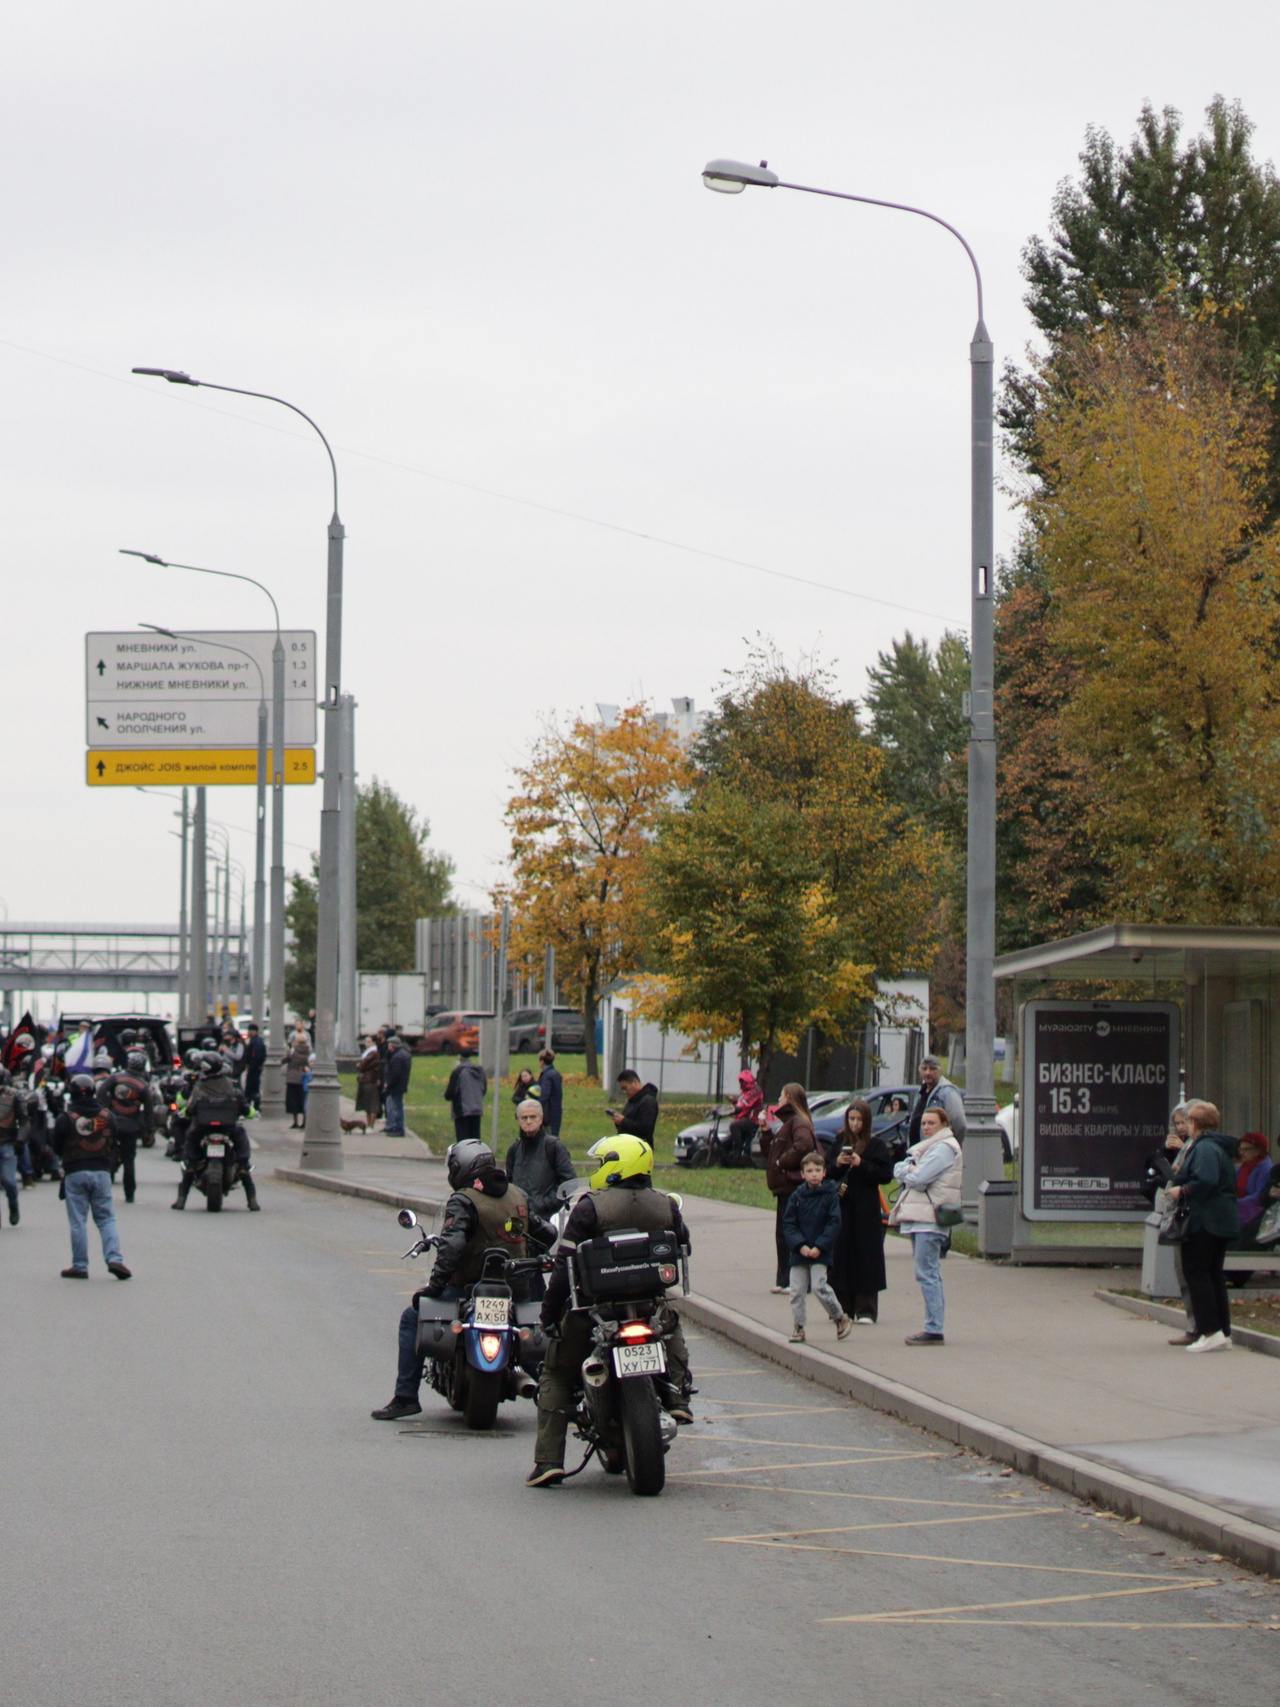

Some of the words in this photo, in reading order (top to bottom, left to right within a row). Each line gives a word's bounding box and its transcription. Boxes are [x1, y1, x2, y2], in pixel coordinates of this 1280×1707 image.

[116, 643, 179, 653] МНЕВНИКИ
[181, 645, 197, 654] ул.
[291, 642, 307, 652] 0.5
[116, 662, 175, 671] МАРШАЛА
[178, 661, 224, 671] ЖУКОВА
[227, 663, 250, 672] пр-т
[292, 661, 307, 670] 1.3
[116, 681, 165, 690] НИЖНИЕ
[167, 680, 230, 690] МНЕВНИКИ
[232, 682, 249, 691] ул.
[292, 680, 307, 689] 1.4
[116, 712, 186, 722] НАРОДНОГО
[116, 724, 187, 734] ОПОЛЧЕНИЯ
[189, 726, 206, 735] ул.
[116, 763, 155, 773] ДЖОЙС
[158, 763, 182, 772] JOIS
[184, 764, 217, 772] жилой
[220, 763, 257, 771] компле
[293, 762, 308, 771] 2.5
[1039, 1024, 1094, 1033] MYPRIORITY
[1112, 1025, 1166, 1033] МНЕВНИКИ
[1039, 1062, 1166, 1084] БИЗНЕС-КЛАСС
[1049, 1087, 1091, 1114] 15.3
[1039, 1123, 1083, 1136] ВИДОВЫЕ
[1084, 1124, 1132, 1137] КВАРТИРЫ
[1134, 1125, 1141, 1135] У
[1142, 1125, 1165, 1136] ЛЕСА
[1042, 1180, 1109, 1189] ГРАНЕЛЬ
[480, 1299, 505, 1310] 1249
[493, 1312, 507, 1323] 50
[624, 1346, 653, 1358] 0523
[644, 1359, 658, 1371] 77
